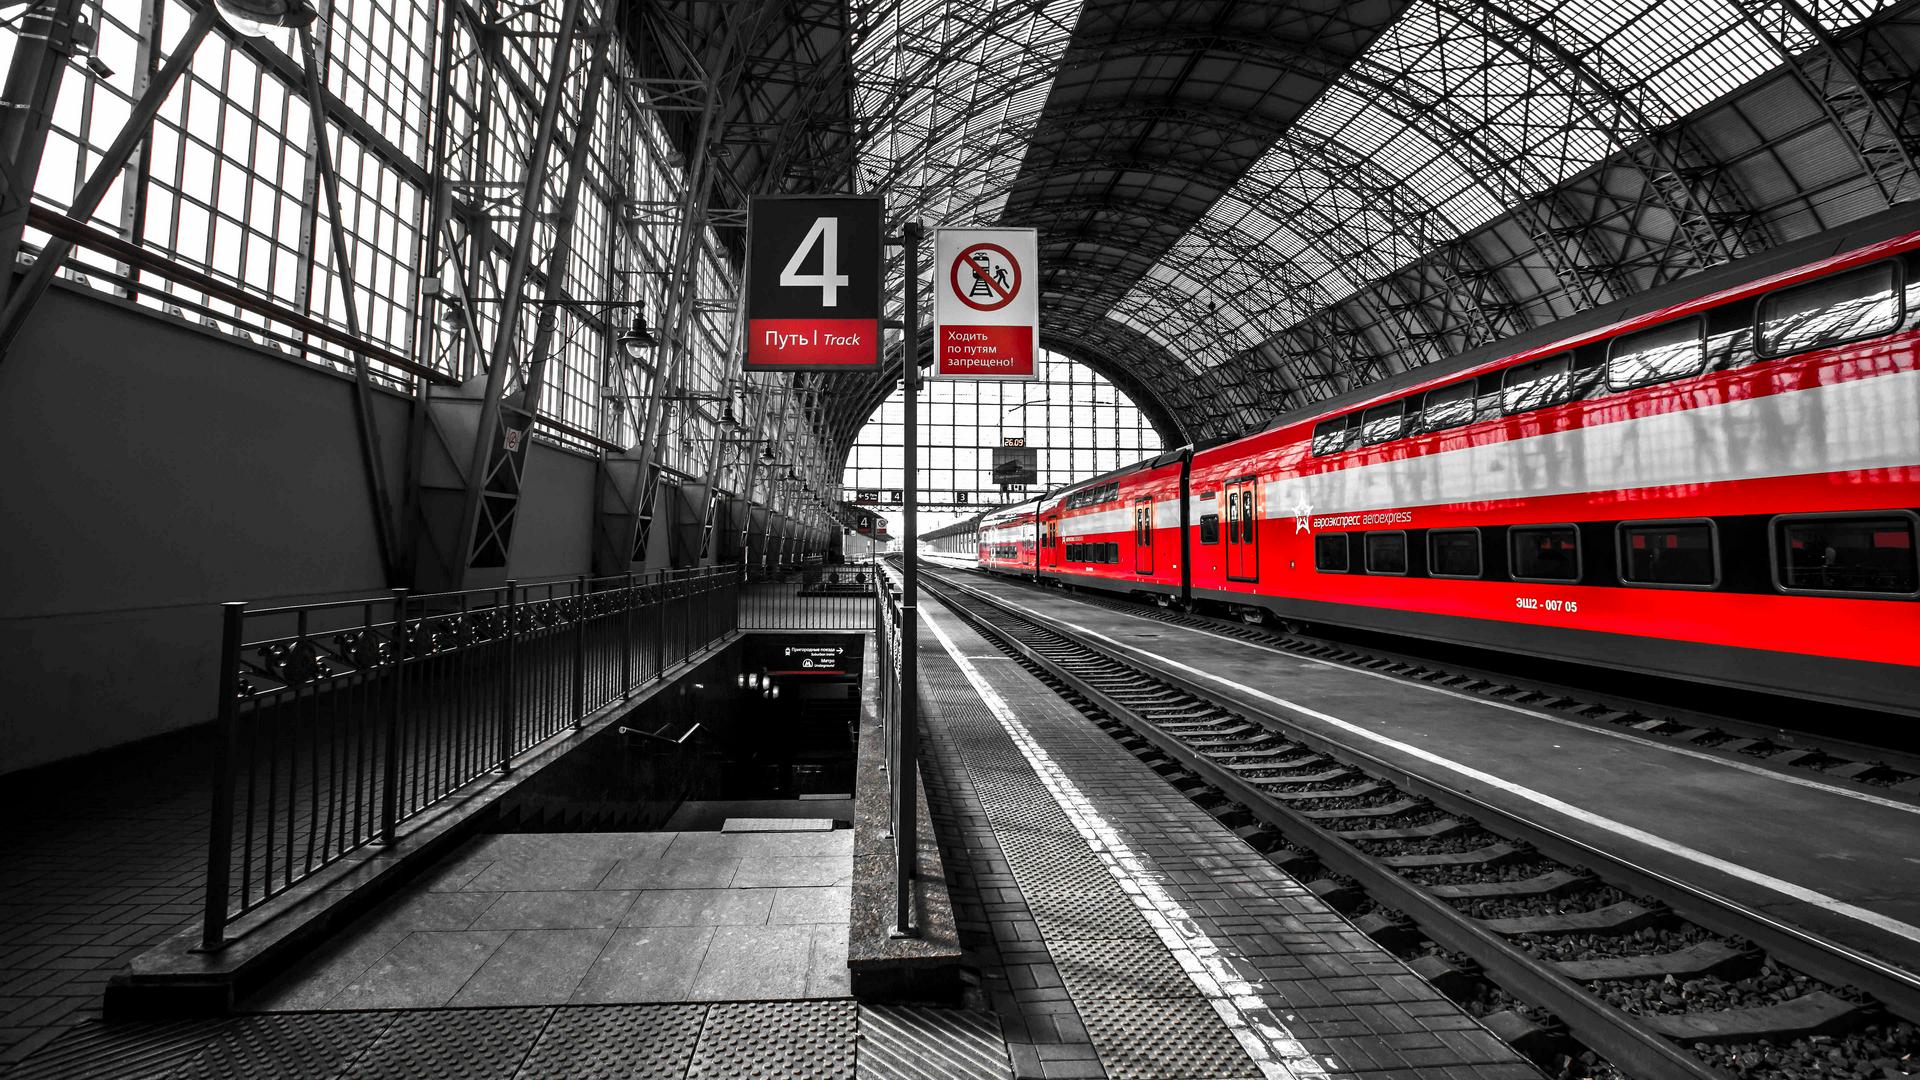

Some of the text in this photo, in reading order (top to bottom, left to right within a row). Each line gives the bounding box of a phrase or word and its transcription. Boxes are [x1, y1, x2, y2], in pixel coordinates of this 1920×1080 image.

[780, 217, 848, 307] 4
[765, 330, 860, 350] Путь Track
[948, 331, 988, 342] Ходить
[947, 345, 997, 356] по путям
[947, 357, 1014, 369] запрещено!
[1004, 438, 1024, 447] 26.09
[864, 493, 870, 501] 5
[894, 492, 900, 500] 4
[960, 493, 966, 501] 3
[860, 517, 868, 528] 4
[1313, 512, 1412, 528] аэроэкспресс aeroexpress
[1516, 598, 1537, 609] ЭШ2
[1545, 599, 1563, 611] 007
[1565, 601, 1577, 612] 05
